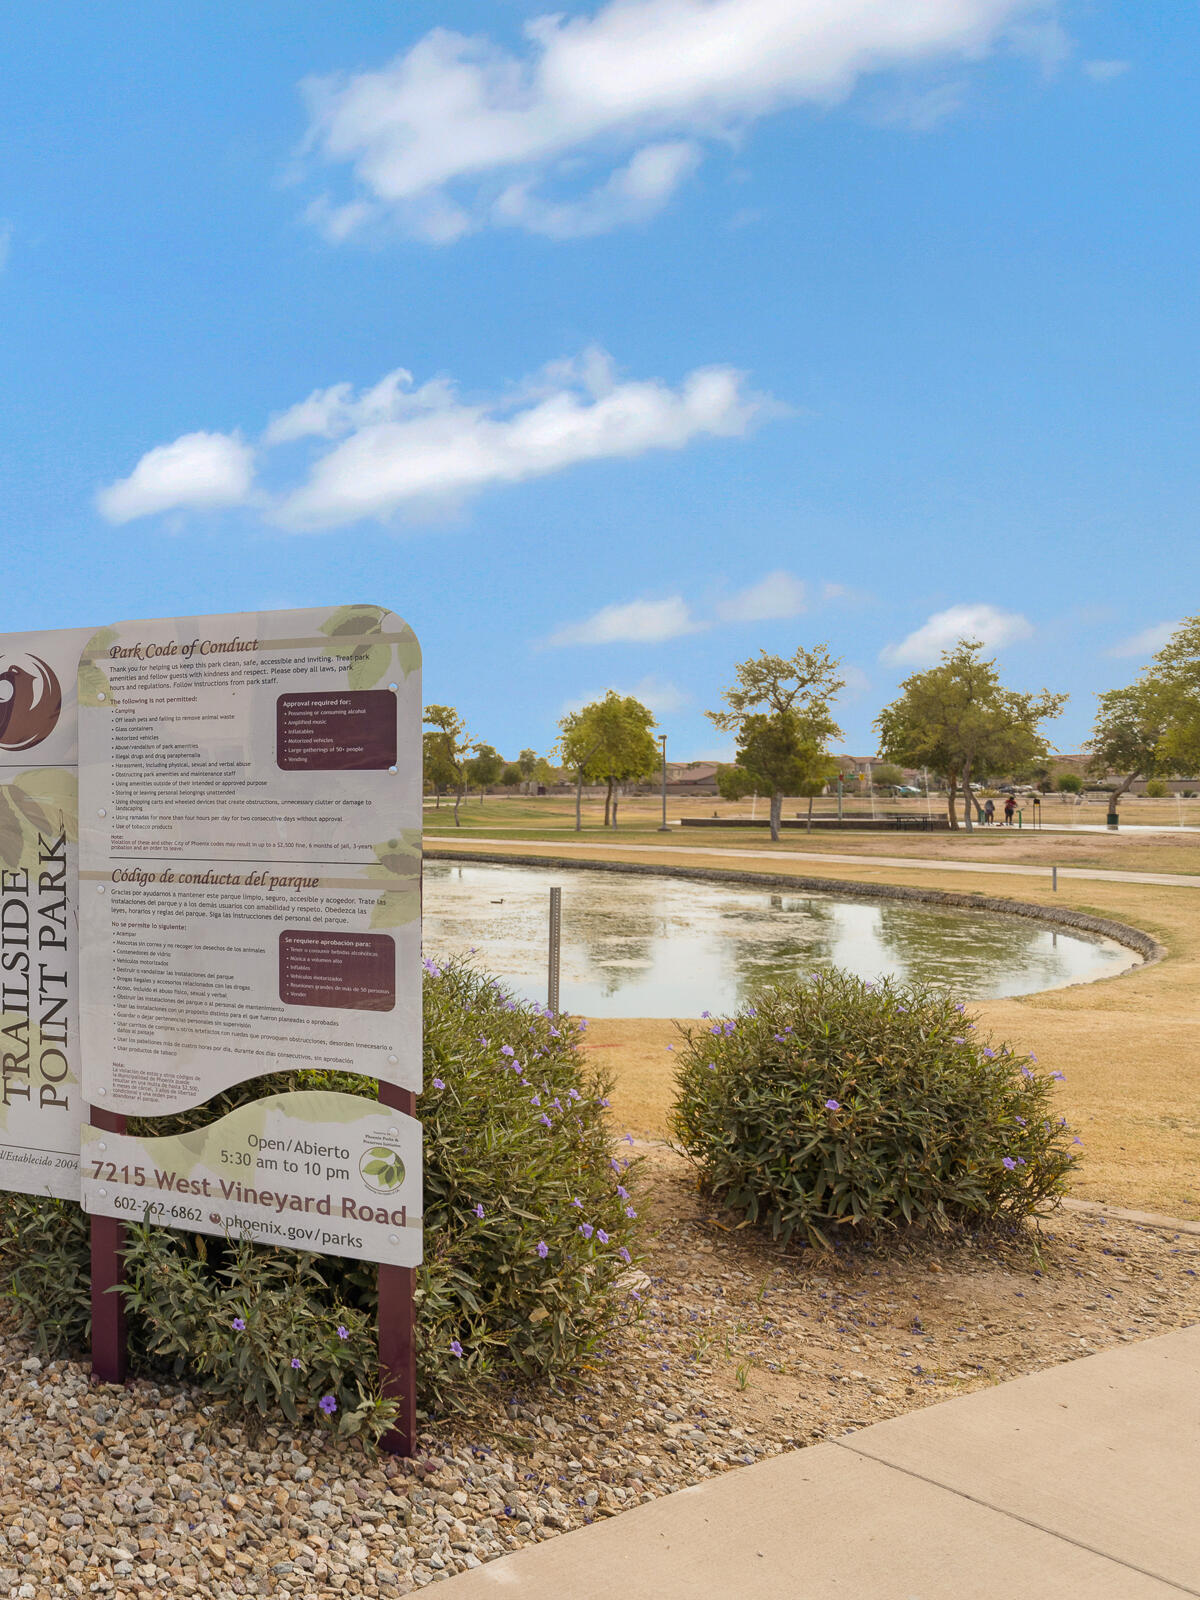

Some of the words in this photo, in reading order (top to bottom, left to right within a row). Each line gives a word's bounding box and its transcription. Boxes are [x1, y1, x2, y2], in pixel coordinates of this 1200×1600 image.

[109, 643, 144, 660] Park
[145, 641, 178, 658] Code
[181, 640, 199, 659] of
[200, 637, 259, 655] Conduct
[149, 664, 170, 672] helping
[180, 663, 194, 671] keep
[208, 661, 221, 670] park
[223, 660, 241, 669] clean,
[243, 659, 259, 668] safe,
[355, 654, 370, 663] park
[169, 672, 188, 681] guests
[243, 668, 269, 678] respect.
[292, 667, 308, 676] obey
[319, 665, 337, 674] laws,
[338, 664, 353, 674] park
[138, 682, 172, 691] regulations.
[246, 679, 260, 687] park
[166, 696, 198, 704] permitted:
[38, 832, 67, 951] PARK
[111, 868, 155, 886] Código
[160, 869, 175, 883] de
[178, 870, 240, 885] conducta
[245, 871, 269, 886] del
[269, 877, 318, 892] parque
[296, 906, 323, 914] respeto.
[325, 898, 356, 906] acogedor.
[285, 915, 311, 923] personal
[1, 867, 30, 1106] TRAILSIDE
[38, 964, 69, 1110] POINT
[248, 1134, 350, 1159] Open/Abierto
[54, 1158, 79, 1170] 2004
[220, 1150, 251, 1166] 5:30
[256, 1158, 277, 1170] am
[284, 1160, 298, 1172] to
[304, 1162, 321, 1176] 10
[326, 1167, 349, 1180] pm
[91, 1160, 146, 1186] 7215
[154, 1168, 211, 1197] West
[219, 1179, 330, 1213] Vineyard
[341, 1197, 406, 1227] Road
[114, 1196, 202, 1222] 602-262-6862
[226, 1215, 362, 1248] phoenix.gov/parks
